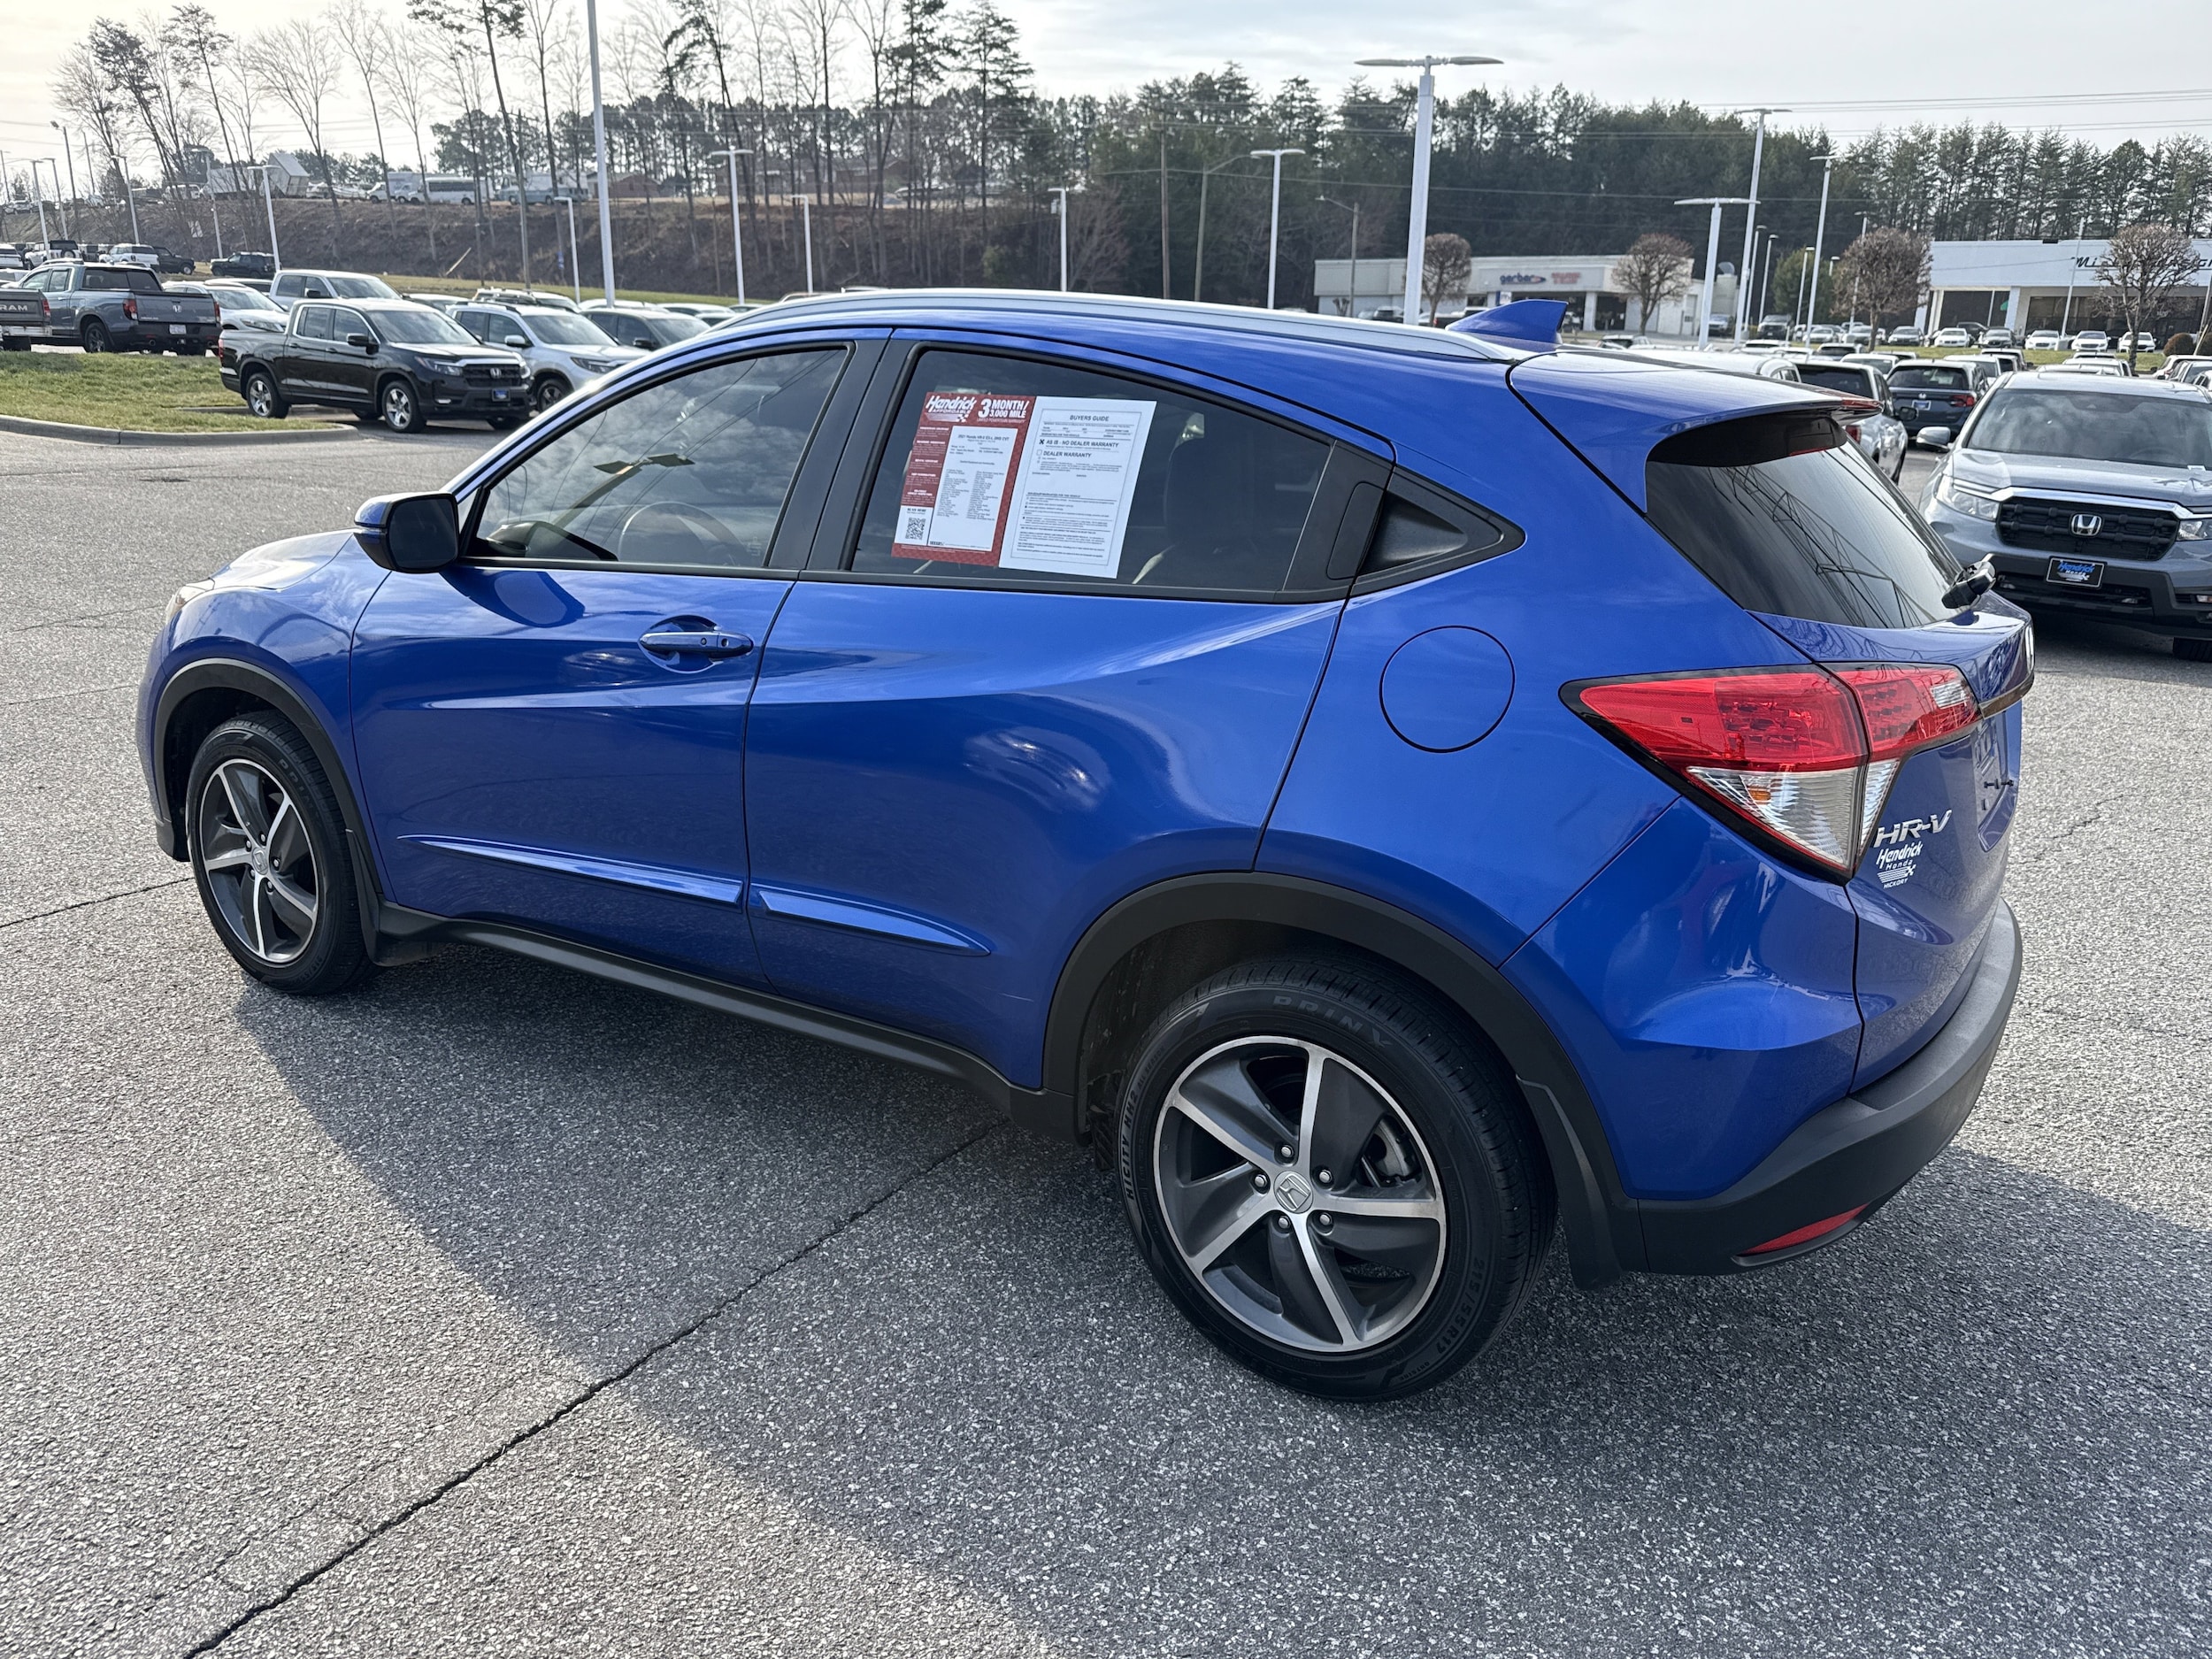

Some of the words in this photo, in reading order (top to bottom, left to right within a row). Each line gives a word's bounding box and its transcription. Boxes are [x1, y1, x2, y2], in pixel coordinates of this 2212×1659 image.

[926, 396, 977, 412] Hendrick
[978, 398, 991, 418] 3
[991, 399, 1030, 410] MONTH/
[1873, 809, 1952, 848] HR-V
[1876, 841, 1924, 869] Hendrick
[1885, 859, 1913, 871] Honda
[1883, 878, 1909, 889] HICKORY
[1273, 995, 1392, 1048] PRINX
[1436, 1256, 1486, 1354] 215/55R17
